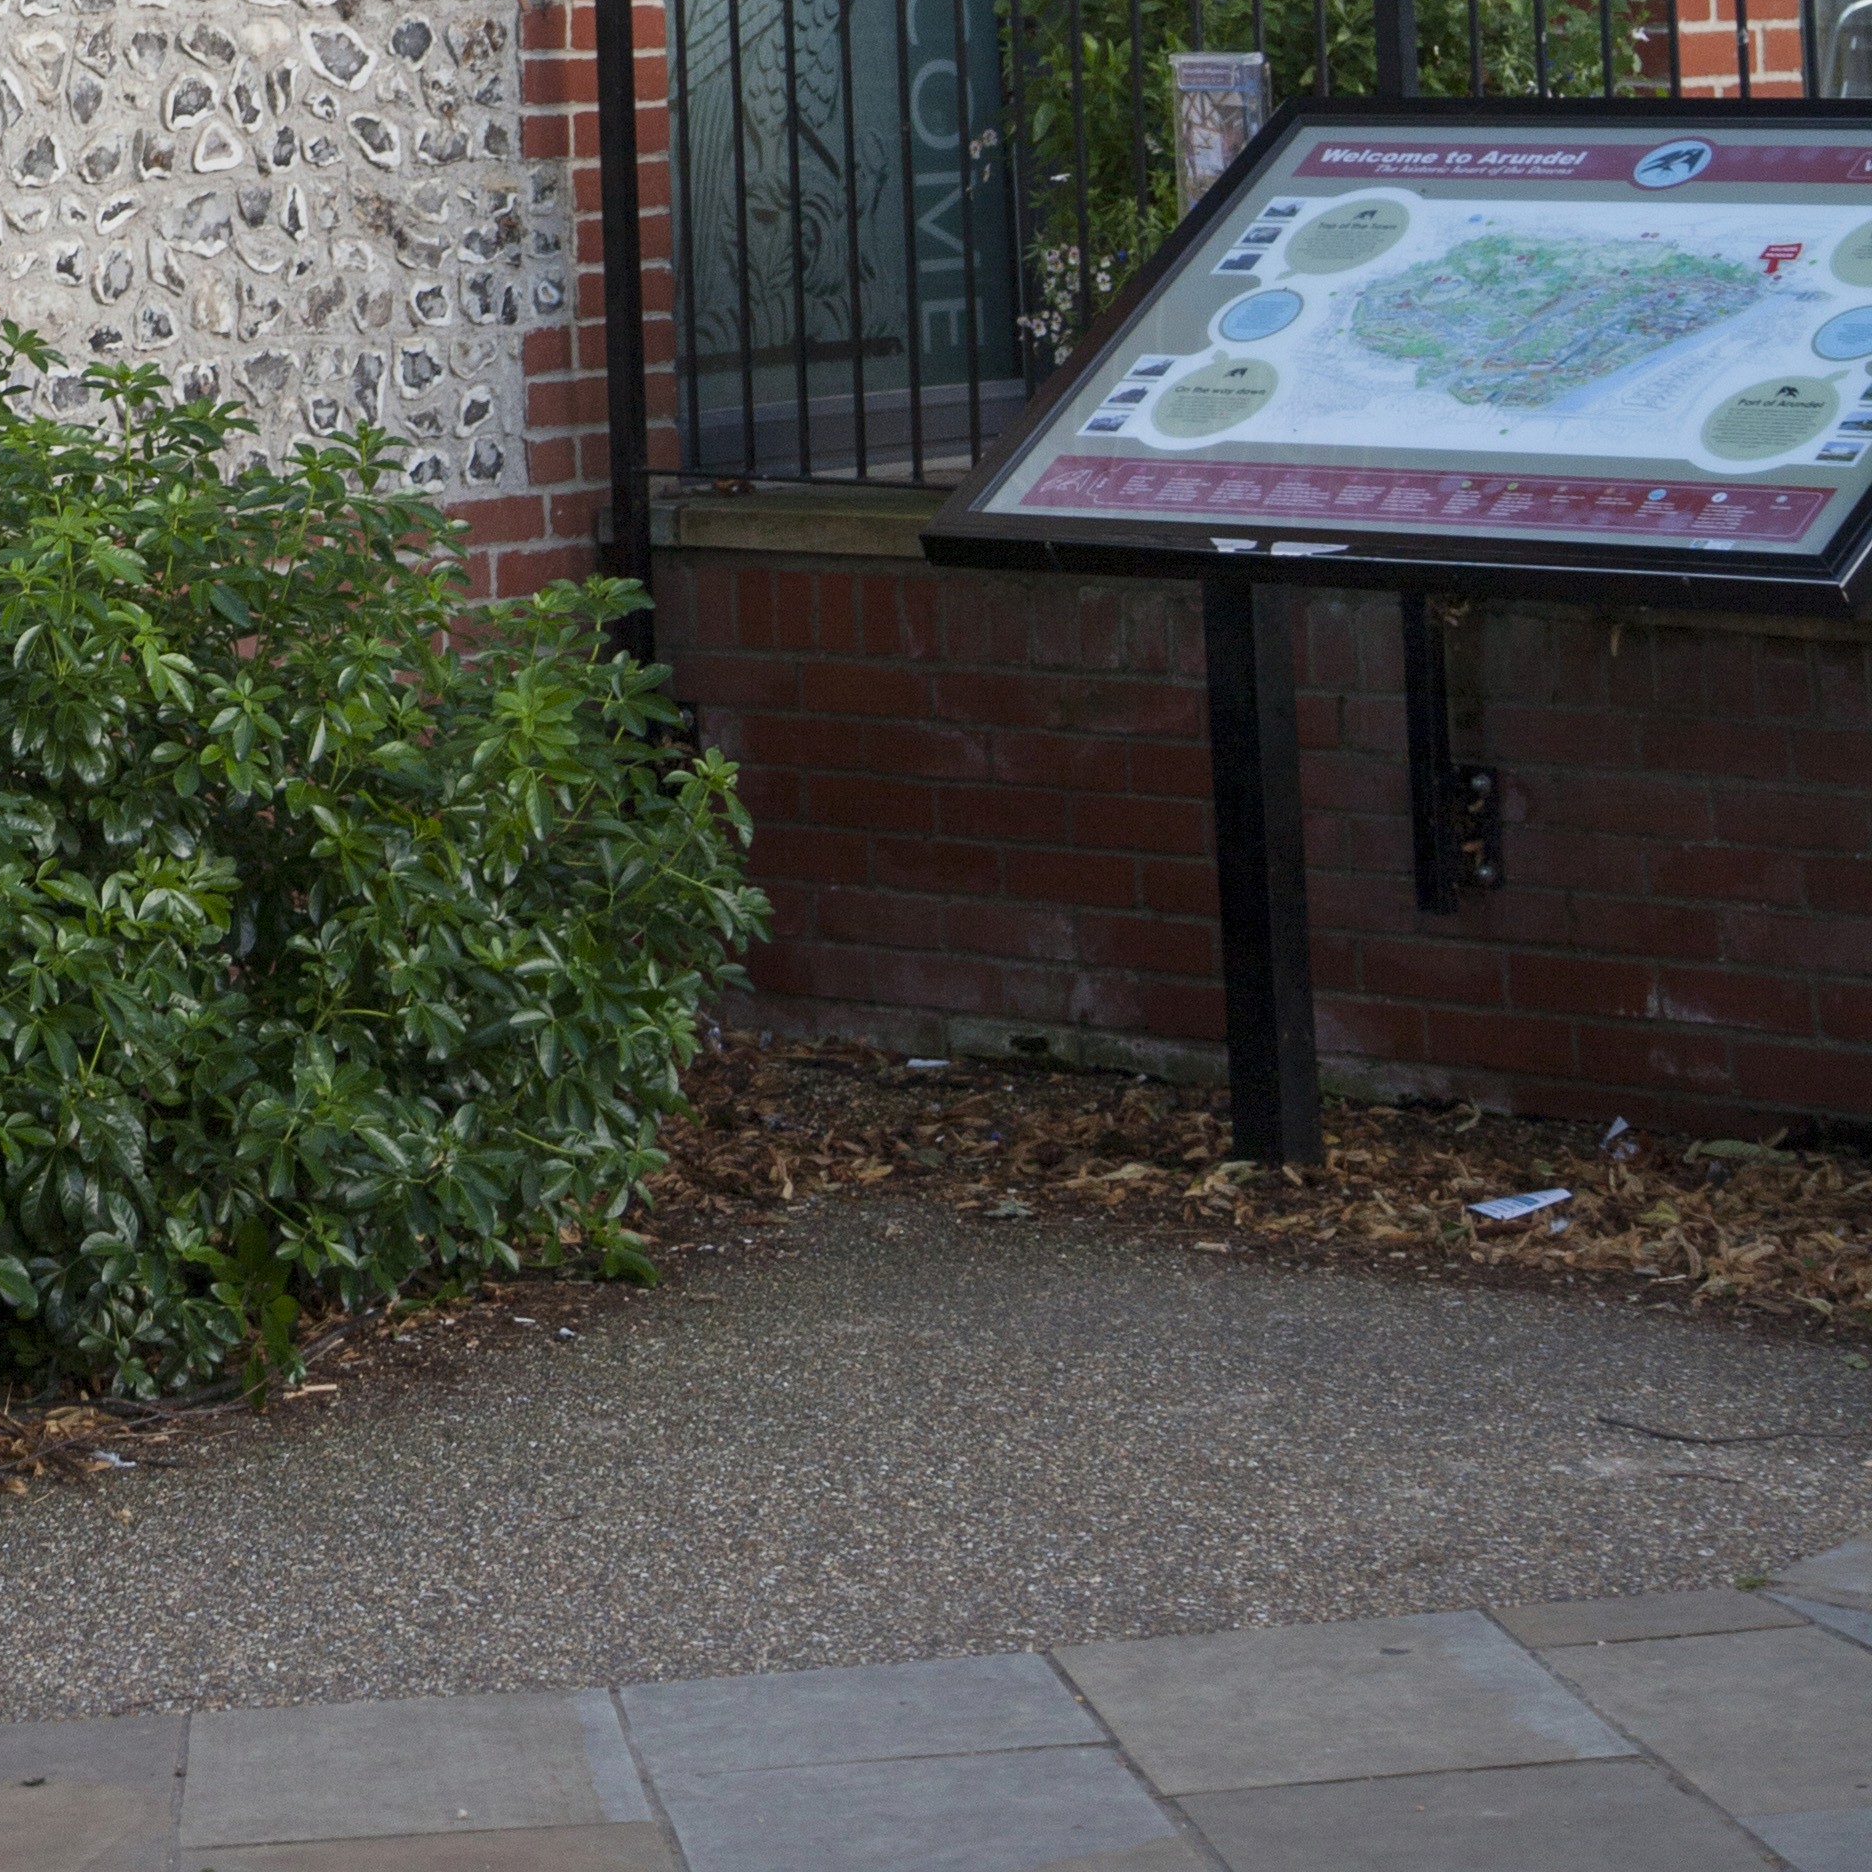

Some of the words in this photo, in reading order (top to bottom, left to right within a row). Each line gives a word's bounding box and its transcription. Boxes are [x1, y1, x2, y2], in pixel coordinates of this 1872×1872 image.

[1320, 148, 1439, 165] Welcome
[1445, 150, 1473, 165] to
[1478, 150, 1589, 166] Arundel
[1374, 164, 1397, 174] The
[1399, 164, 1448, 174] historic
[1450, 165, 1486, 174] heart
[1506, 165, 1525, 174] the
[1527, 166, 1574, 175] Downs
[1737, 398, 1761, 406] Port
[1777, 400, 1826, 409] Arundel
